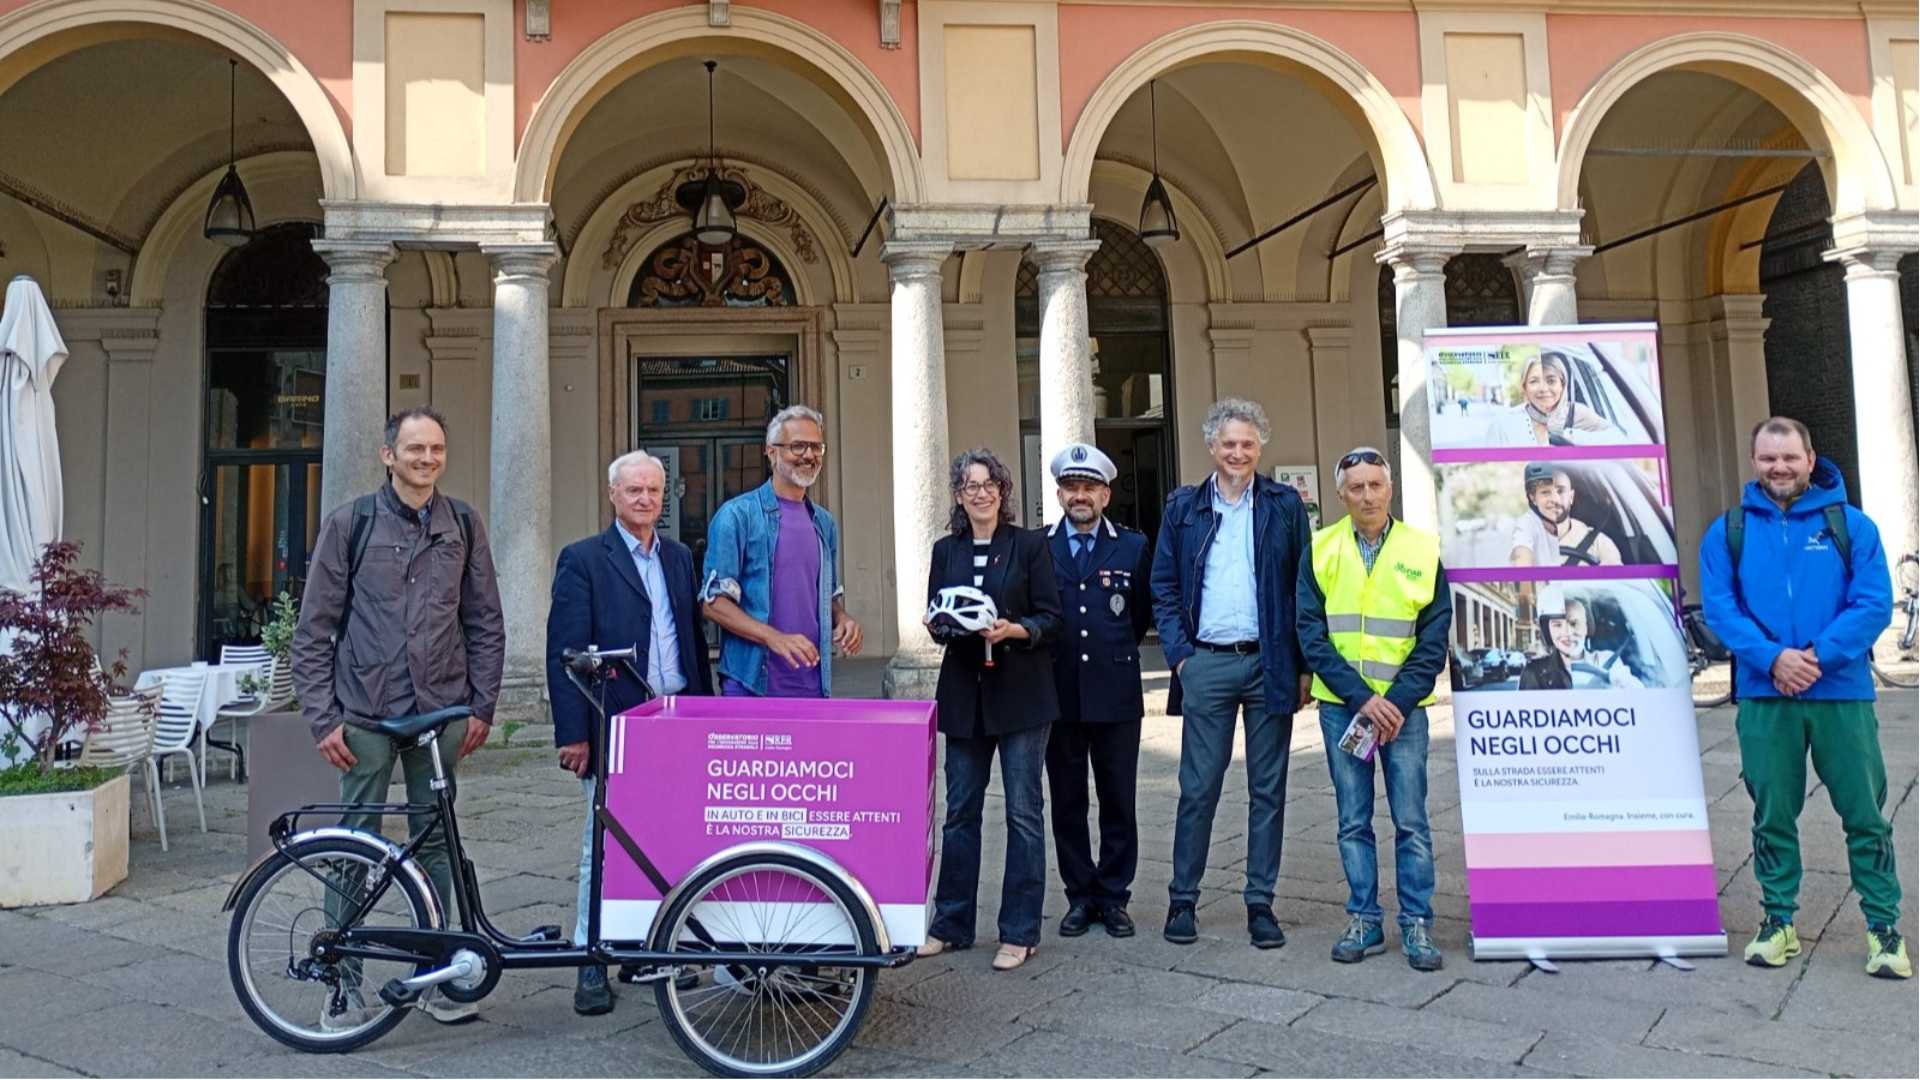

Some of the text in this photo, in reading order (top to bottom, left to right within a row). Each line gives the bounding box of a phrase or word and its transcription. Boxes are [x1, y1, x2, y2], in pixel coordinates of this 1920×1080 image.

[1467, 707, 1637, 730] GUARDIAMOCI
[1470, 734, 1621, 756] NEGLI OCCHI
[707, 760, 854, 779] GUARDIAMOCI
[1473, 766, 1605, 776] SULLA STRADA ESSERE ATTENTI
[1481, 779, 1493, 787] LA
[1494, 778, 1529, 787] NOSTRA
[707, 783, 837, 802] NEGLI OCCHI
[707, 809, 901, 823] IN AUTO E IN BICI ESSERE ATTENTI
[715, 824, 730, 835] LA
[732, 824, 780, 836] NOSTRA
